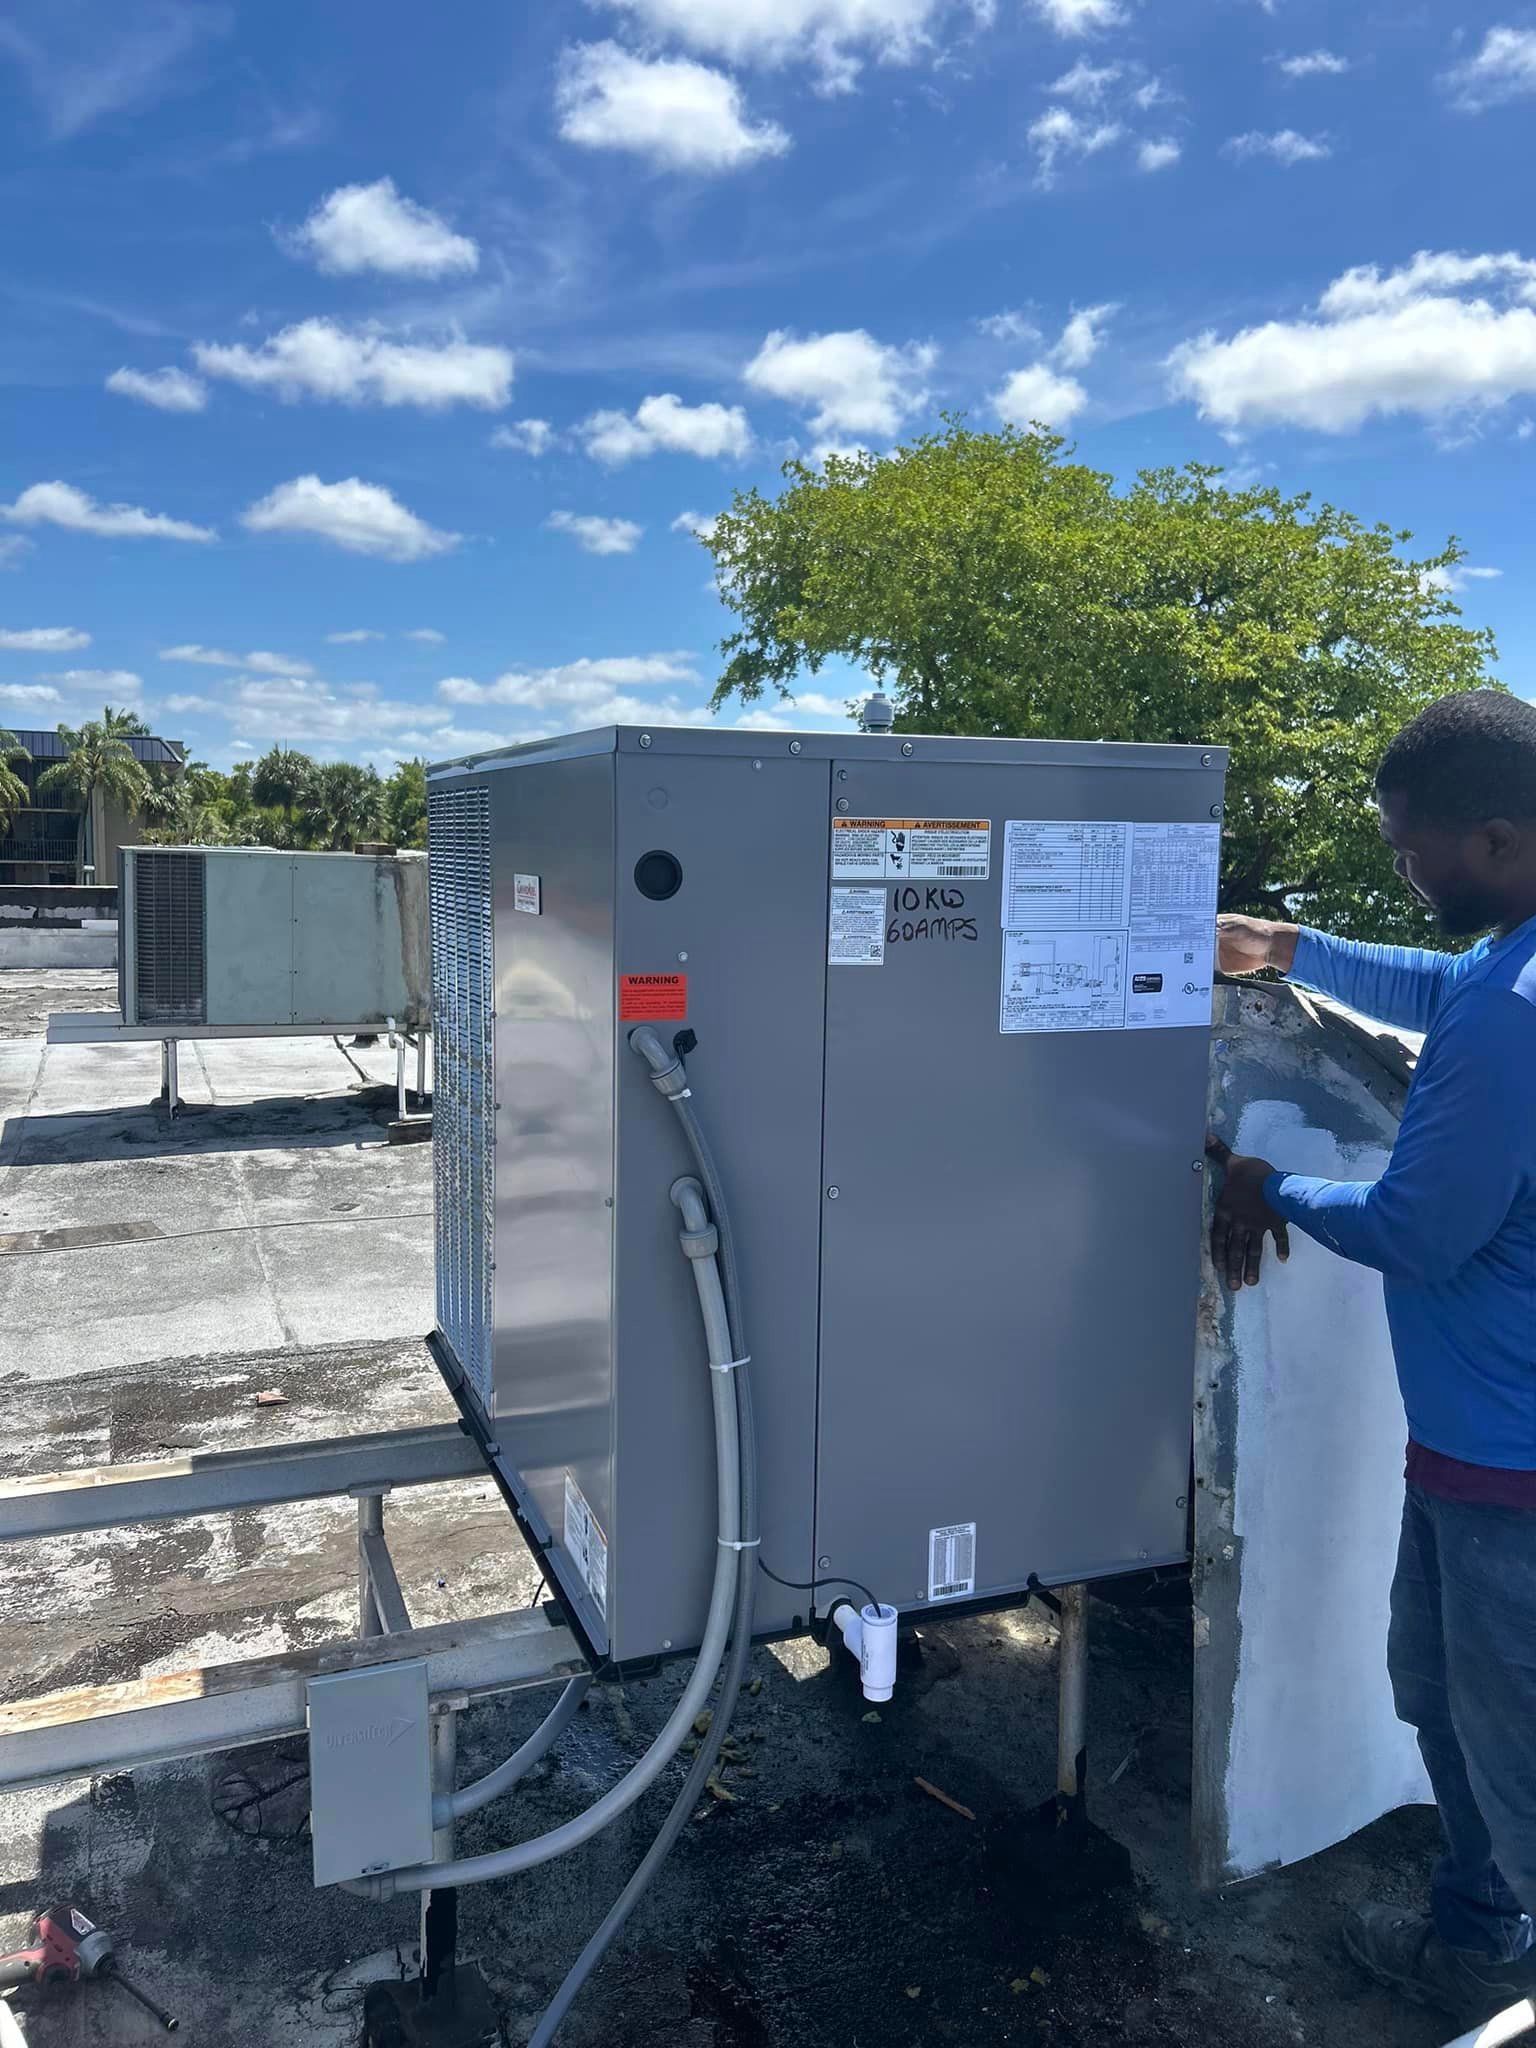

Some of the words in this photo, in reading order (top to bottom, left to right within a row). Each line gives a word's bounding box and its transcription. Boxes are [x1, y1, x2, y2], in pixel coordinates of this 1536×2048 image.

[849, 820, 886, 828] WARNING
[922, 821, 981, 829] AVERTISSEMENT
[893, 887, 920, 912] 10
[627, 975, 679, 985] WARNING
